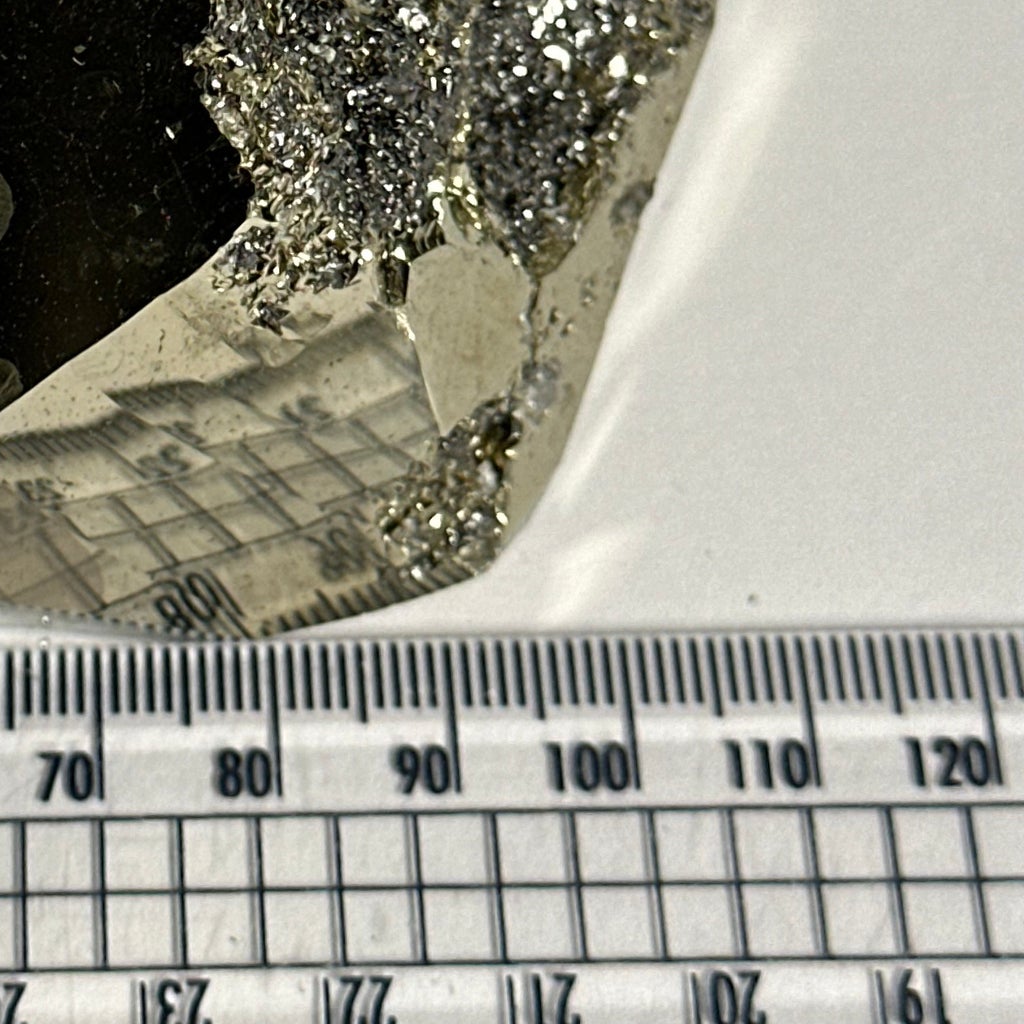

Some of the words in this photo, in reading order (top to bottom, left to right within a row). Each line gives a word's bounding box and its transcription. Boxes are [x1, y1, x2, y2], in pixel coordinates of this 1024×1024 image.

[35, 750, 94, 802] 70
[213, 747, 273, 798] 80
[391, 744, 450, 795] 90
[546, 741, 630, 793] 100
[724, 739, 811, 789] 110
[906, 736, 991, 788] 120
[152, 978, 212, 1024] 23
[336, 975, 397, 1024] 22
[529, 972, 580, 1024] 21
[706, 969, 764, 1024] 20
[894, 967, 950, 1024] 19
